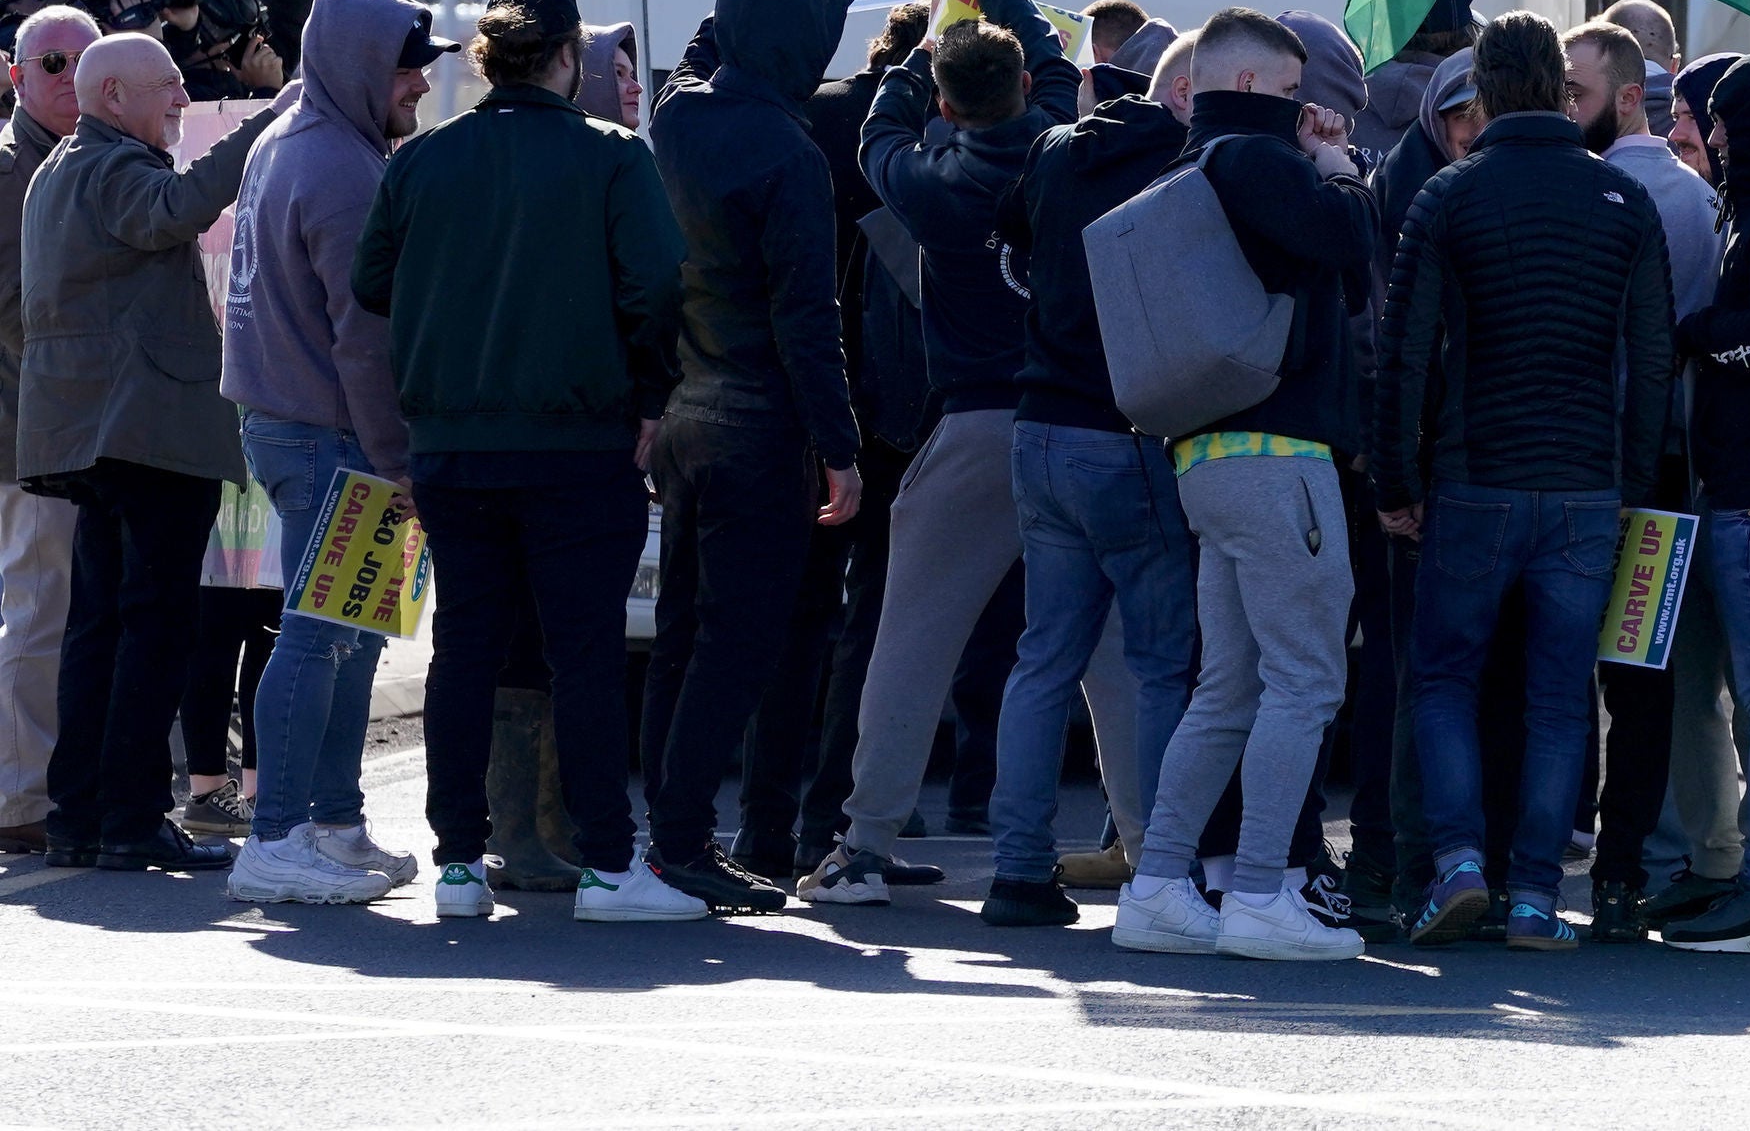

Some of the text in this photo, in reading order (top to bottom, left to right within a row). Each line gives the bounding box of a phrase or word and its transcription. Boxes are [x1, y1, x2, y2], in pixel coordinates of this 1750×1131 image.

[296, 490, 339, 591] www.rmt.org.uk
[310, 481, 371, 609] CARVE UP
[342, 551, 383, 619] JOBS
[1616, 519, 1663, 654] CARVE UP
[1654, 537, 1687, 645] www.rmt.org.uk
[372, 577, 408, 623] THE
